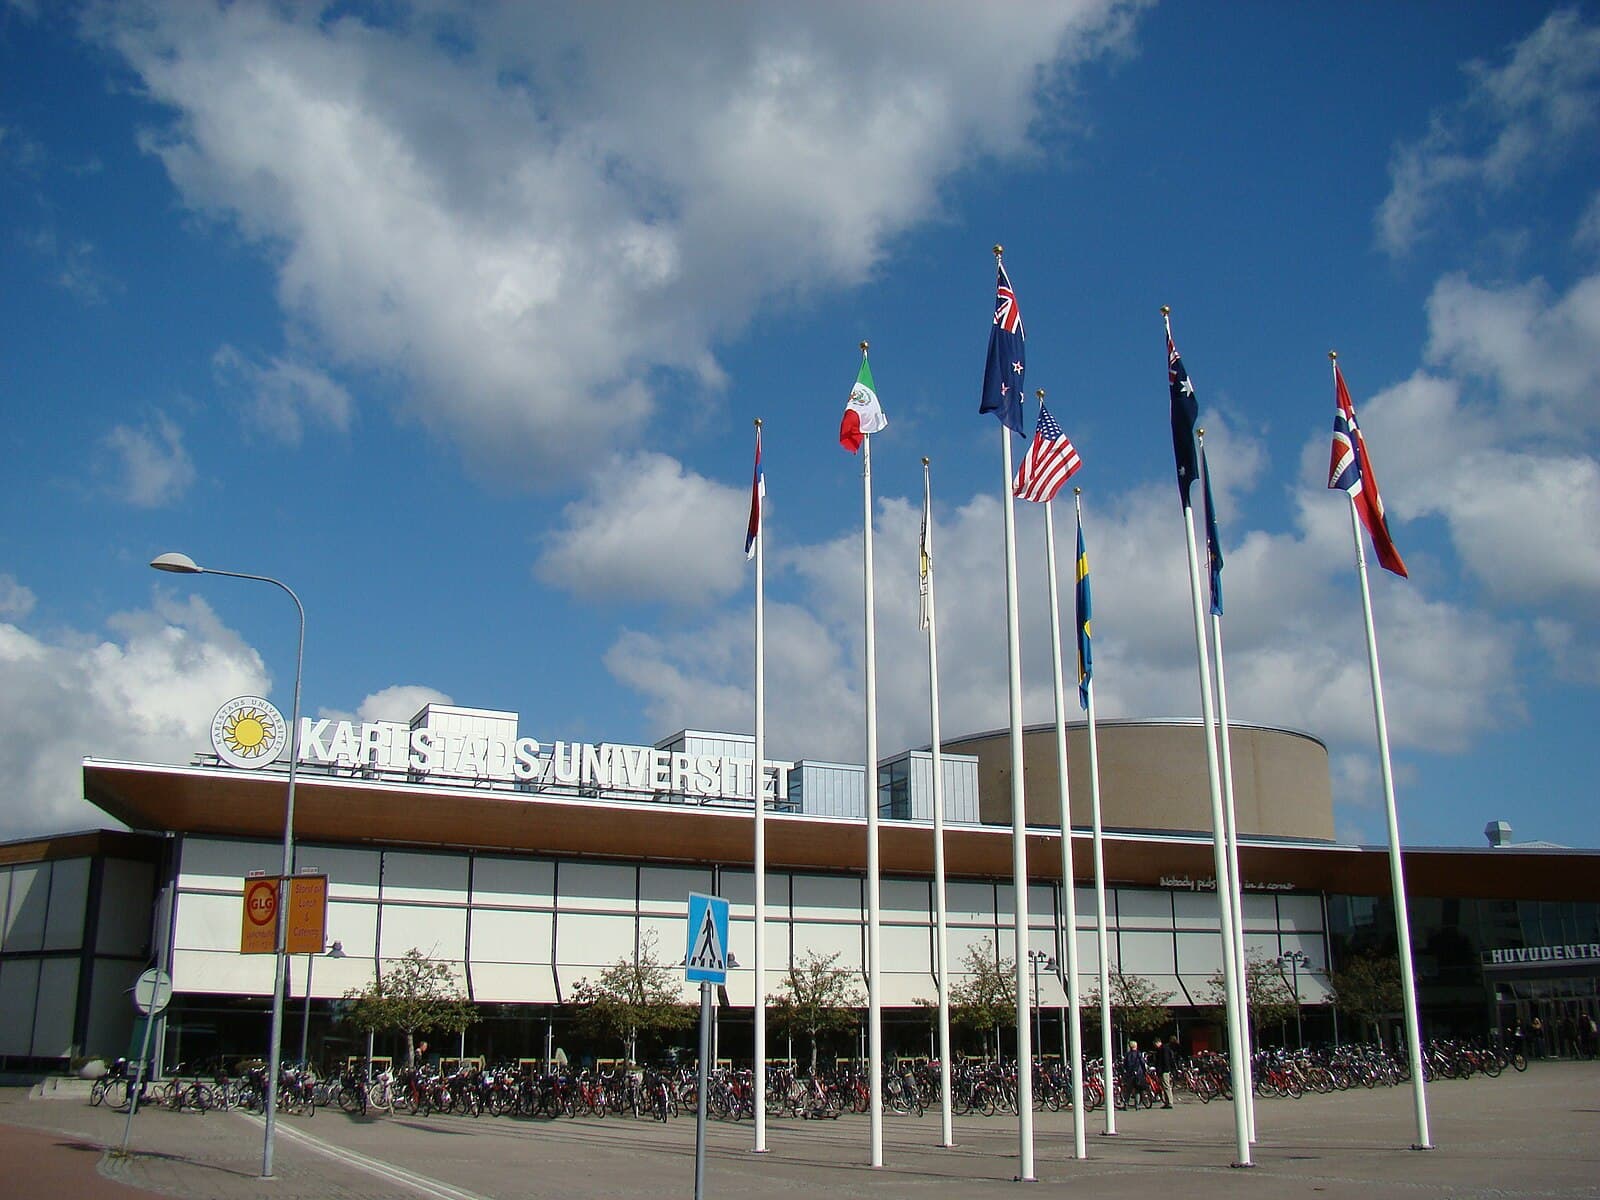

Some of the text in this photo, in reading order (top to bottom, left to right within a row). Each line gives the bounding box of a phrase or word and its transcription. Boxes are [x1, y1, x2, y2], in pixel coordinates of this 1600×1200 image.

[214, 699, 284, 751] KARLSTADS UNIVERSITET
[300, 717, 794, 800] KARLSTADS UNIVERSITET
[1160, 874, 1195, 891] Nobody
[251, 898, 273, 910] GLG
[1491, 943, 1600, 963] HUVUDENTR
